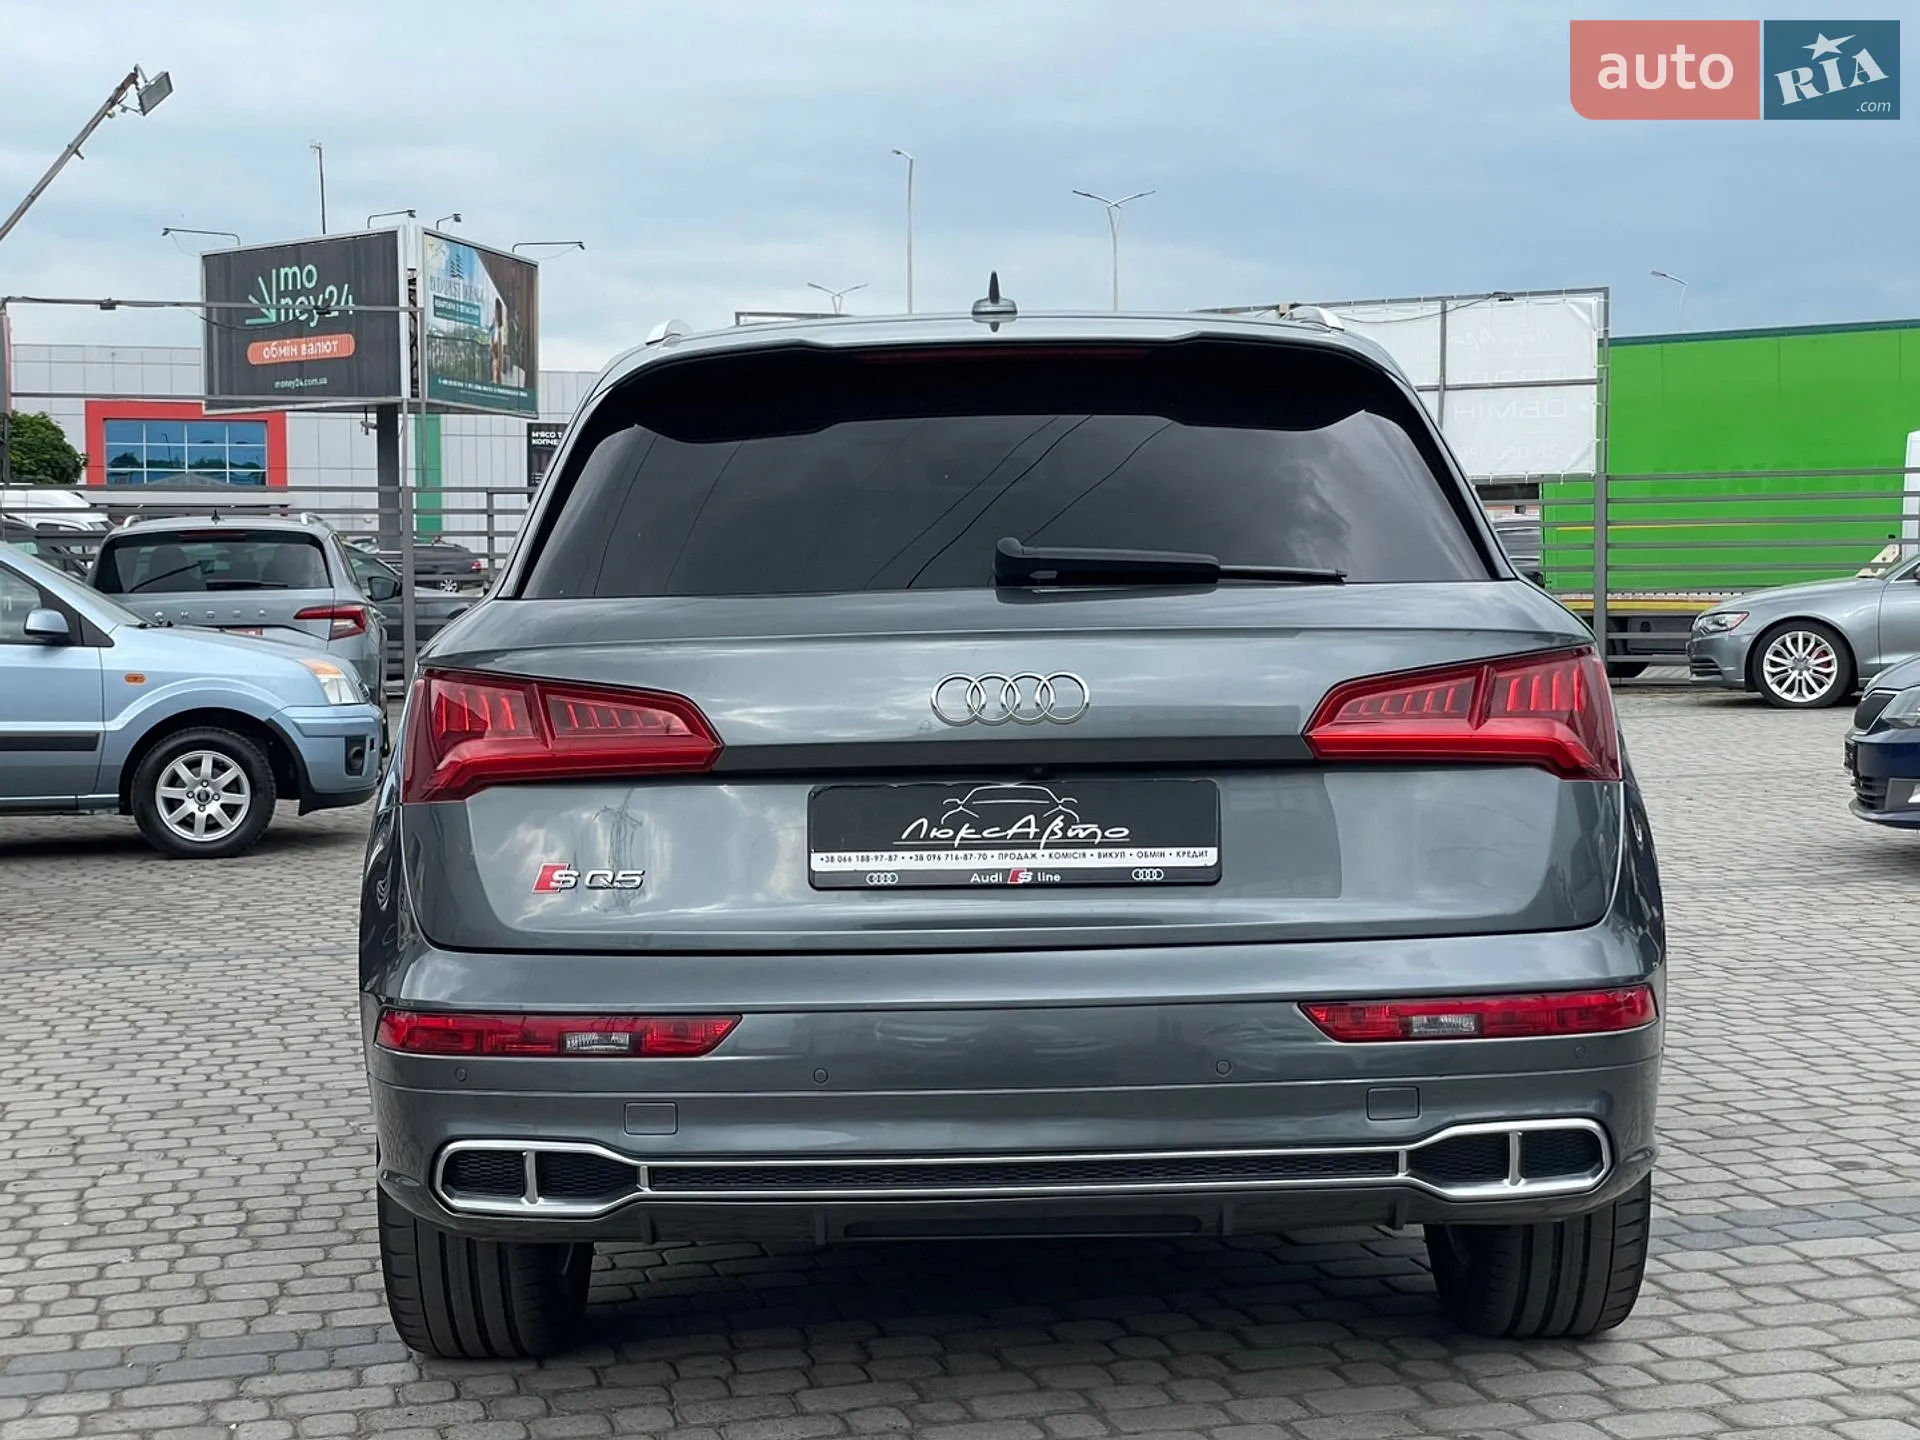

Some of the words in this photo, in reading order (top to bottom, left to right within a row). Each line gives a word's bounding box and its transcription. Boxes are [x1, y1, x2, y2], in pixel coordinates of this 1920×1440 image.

[280, 263, 318, 291] mo
[280, 283, 355, 328] ney24
[262, 340, 298, 360] обмін
[301, 340, 339, 356] валют
[927, 854, 941, 862] 096
[945, 853, 988, 861] 716-87-70
[998, 852, 1038, 861] ПРОДАЖ
[1049, 852, 1087, 860] КОМІСІЯ
[1098, 851, 1126, 860] ВИКУП
[1137, 850, 1166, 859] ОБМІН
[1176, 850, 1209, 858] КРЕДИТ
[970, 872, 1003, 884] Audi
[1037, 871, 1062, 883] line
